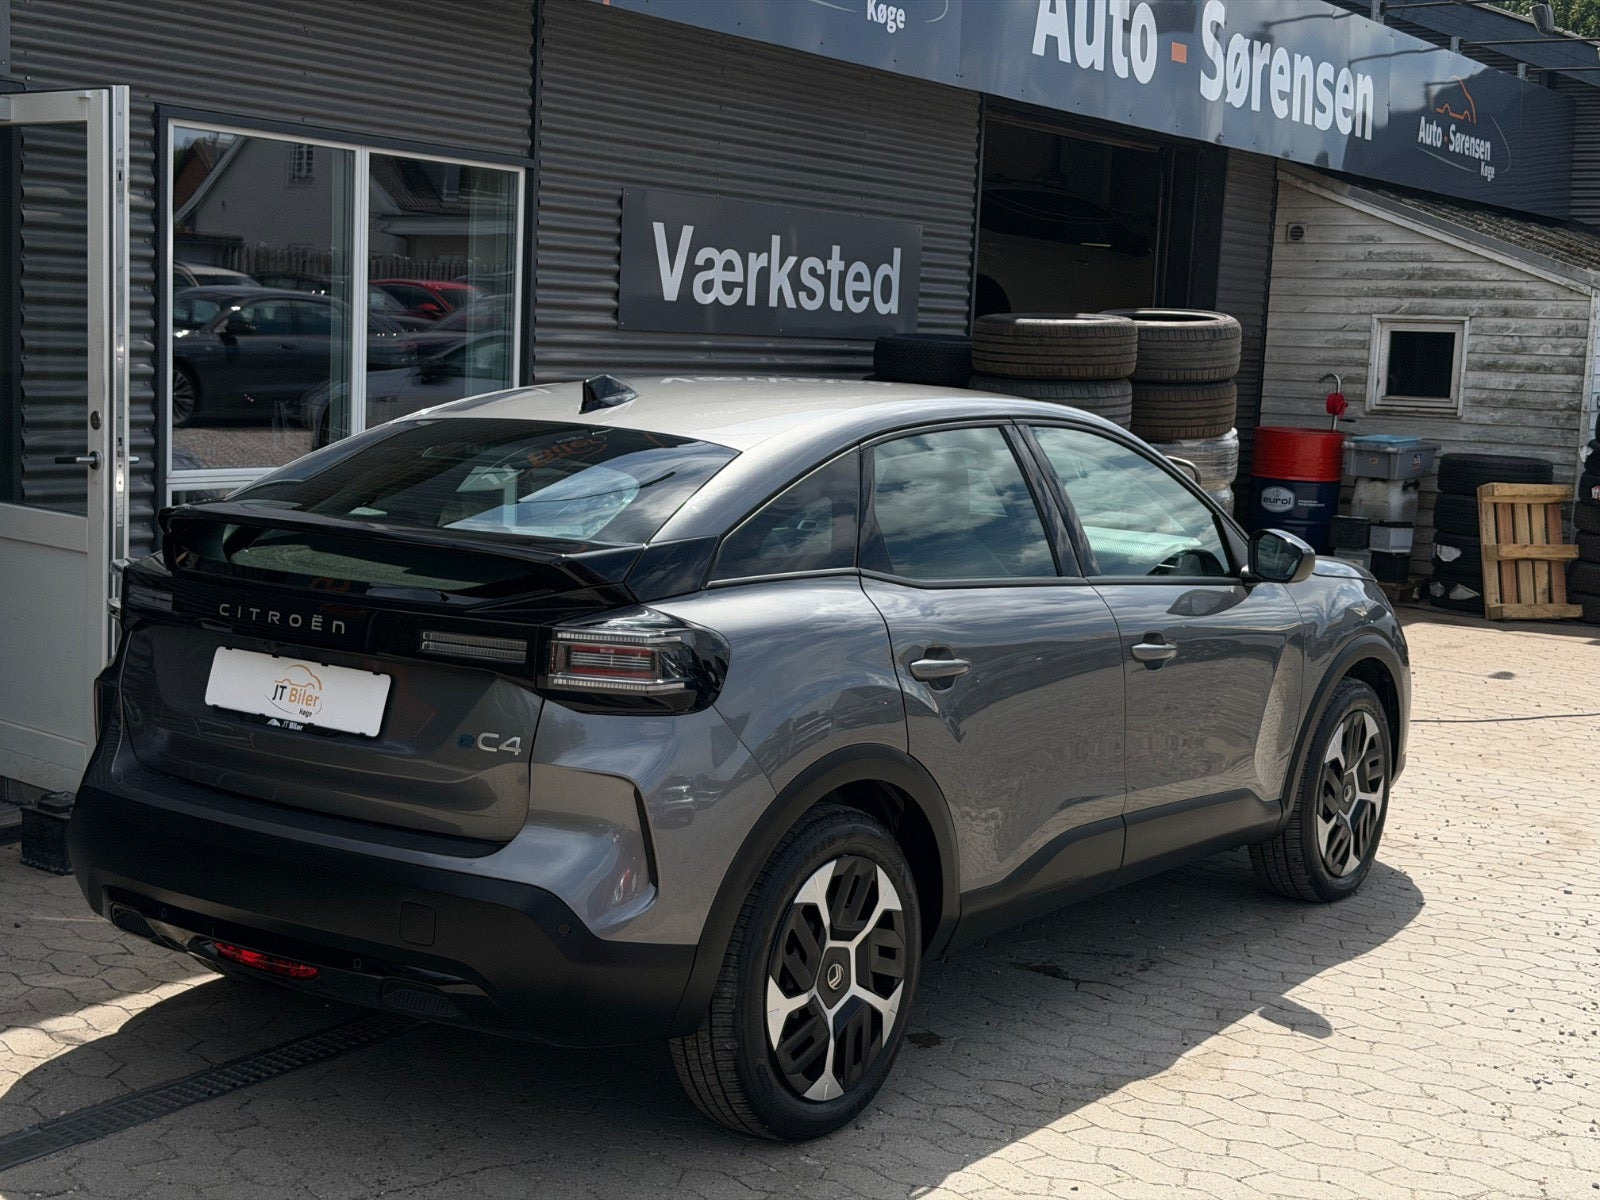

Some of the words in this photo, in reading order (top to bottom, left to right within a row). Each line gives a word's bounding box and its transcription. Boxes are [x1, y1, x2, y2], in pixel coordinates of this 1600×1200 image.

[867, 0, 905, 33] Køge
[1032, 0, 1157, 84] Auto
[1200, 0, 1374, 141] Sørensen
[1417, 116, 1442, 148] Auto
[1448, 123, 1491, 161] Sørensen
[652, 221, 902, 315] Værksted
[272, 684, 287, 701] JT
[288, 687, 320, 707] Biler
[477, 732, 522, 756] C4
